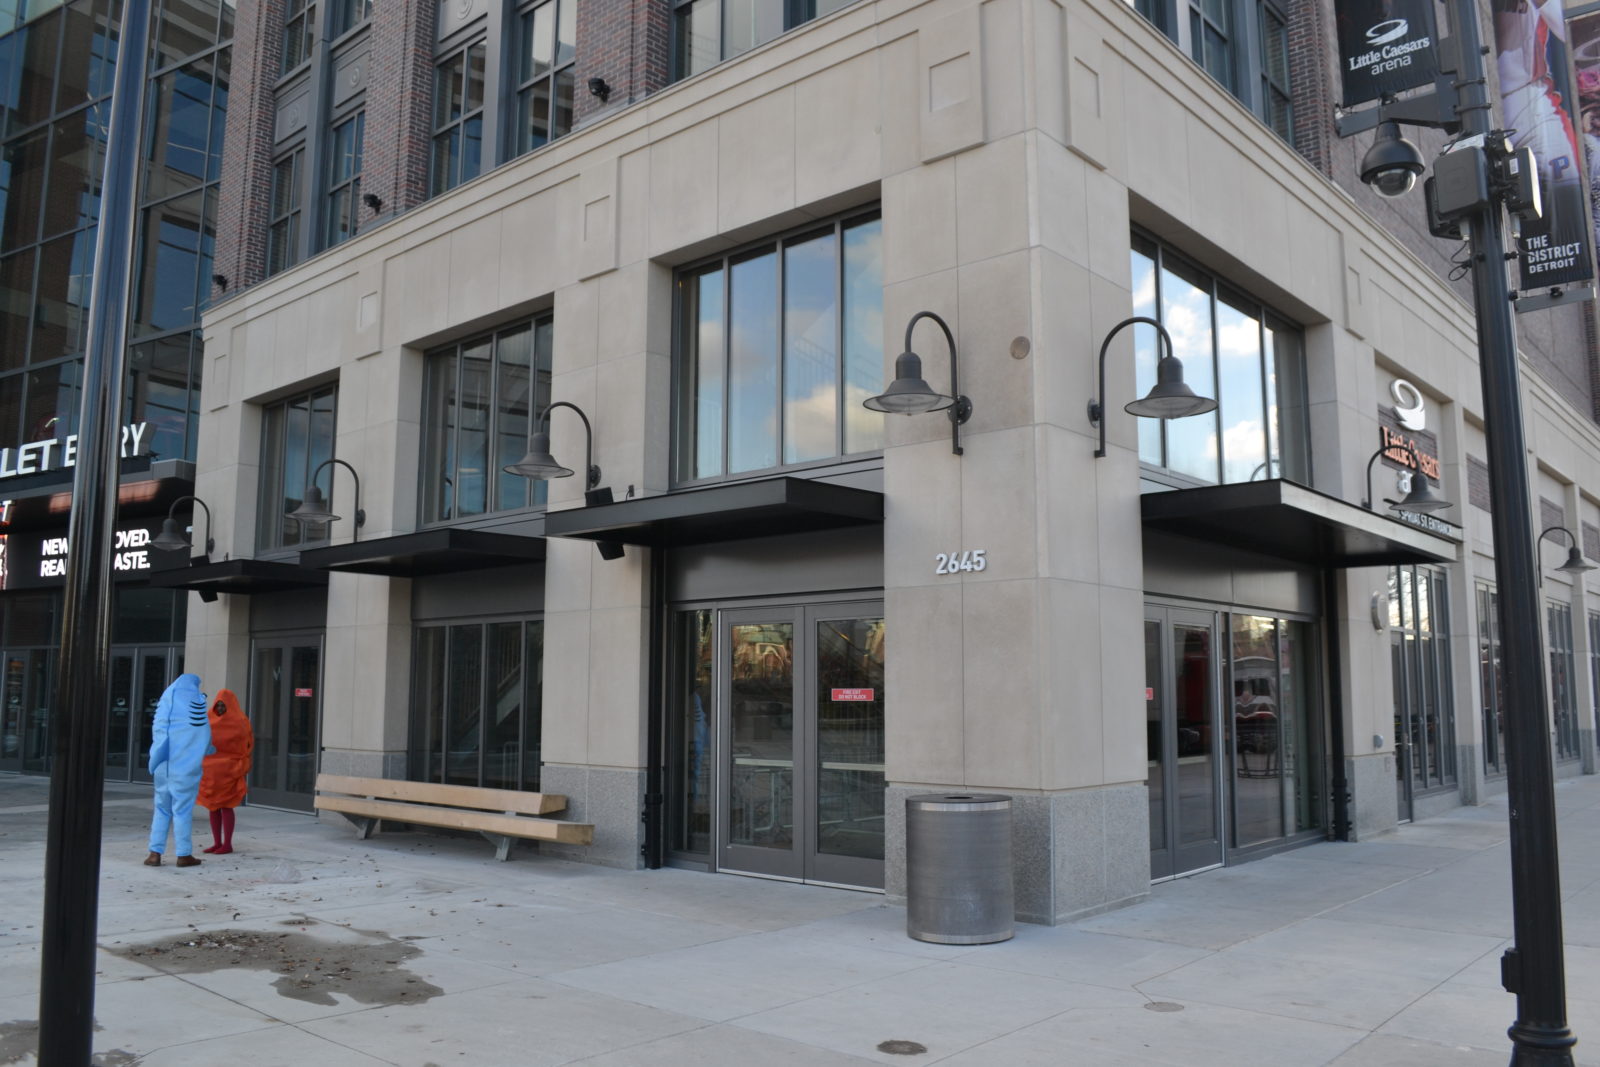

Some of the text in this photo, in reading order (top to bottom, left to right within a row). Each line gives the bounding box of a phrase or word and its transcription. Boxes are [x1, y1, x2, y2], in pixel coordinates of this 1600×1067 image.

[1349, 37, 1430, 70] Little Caesars
[1371, 55, 1412, 75] arena
[1526, 234, 1548, 250] THE
[1527, 242, 1581, 264] DISTRICT
[1529, 257, 1575, 274] DETROIT
[64, 422, 147, 467] ERY
[40, 550, 151, 577] REA ASTE.
[935, 549, 987, 575] 2645
